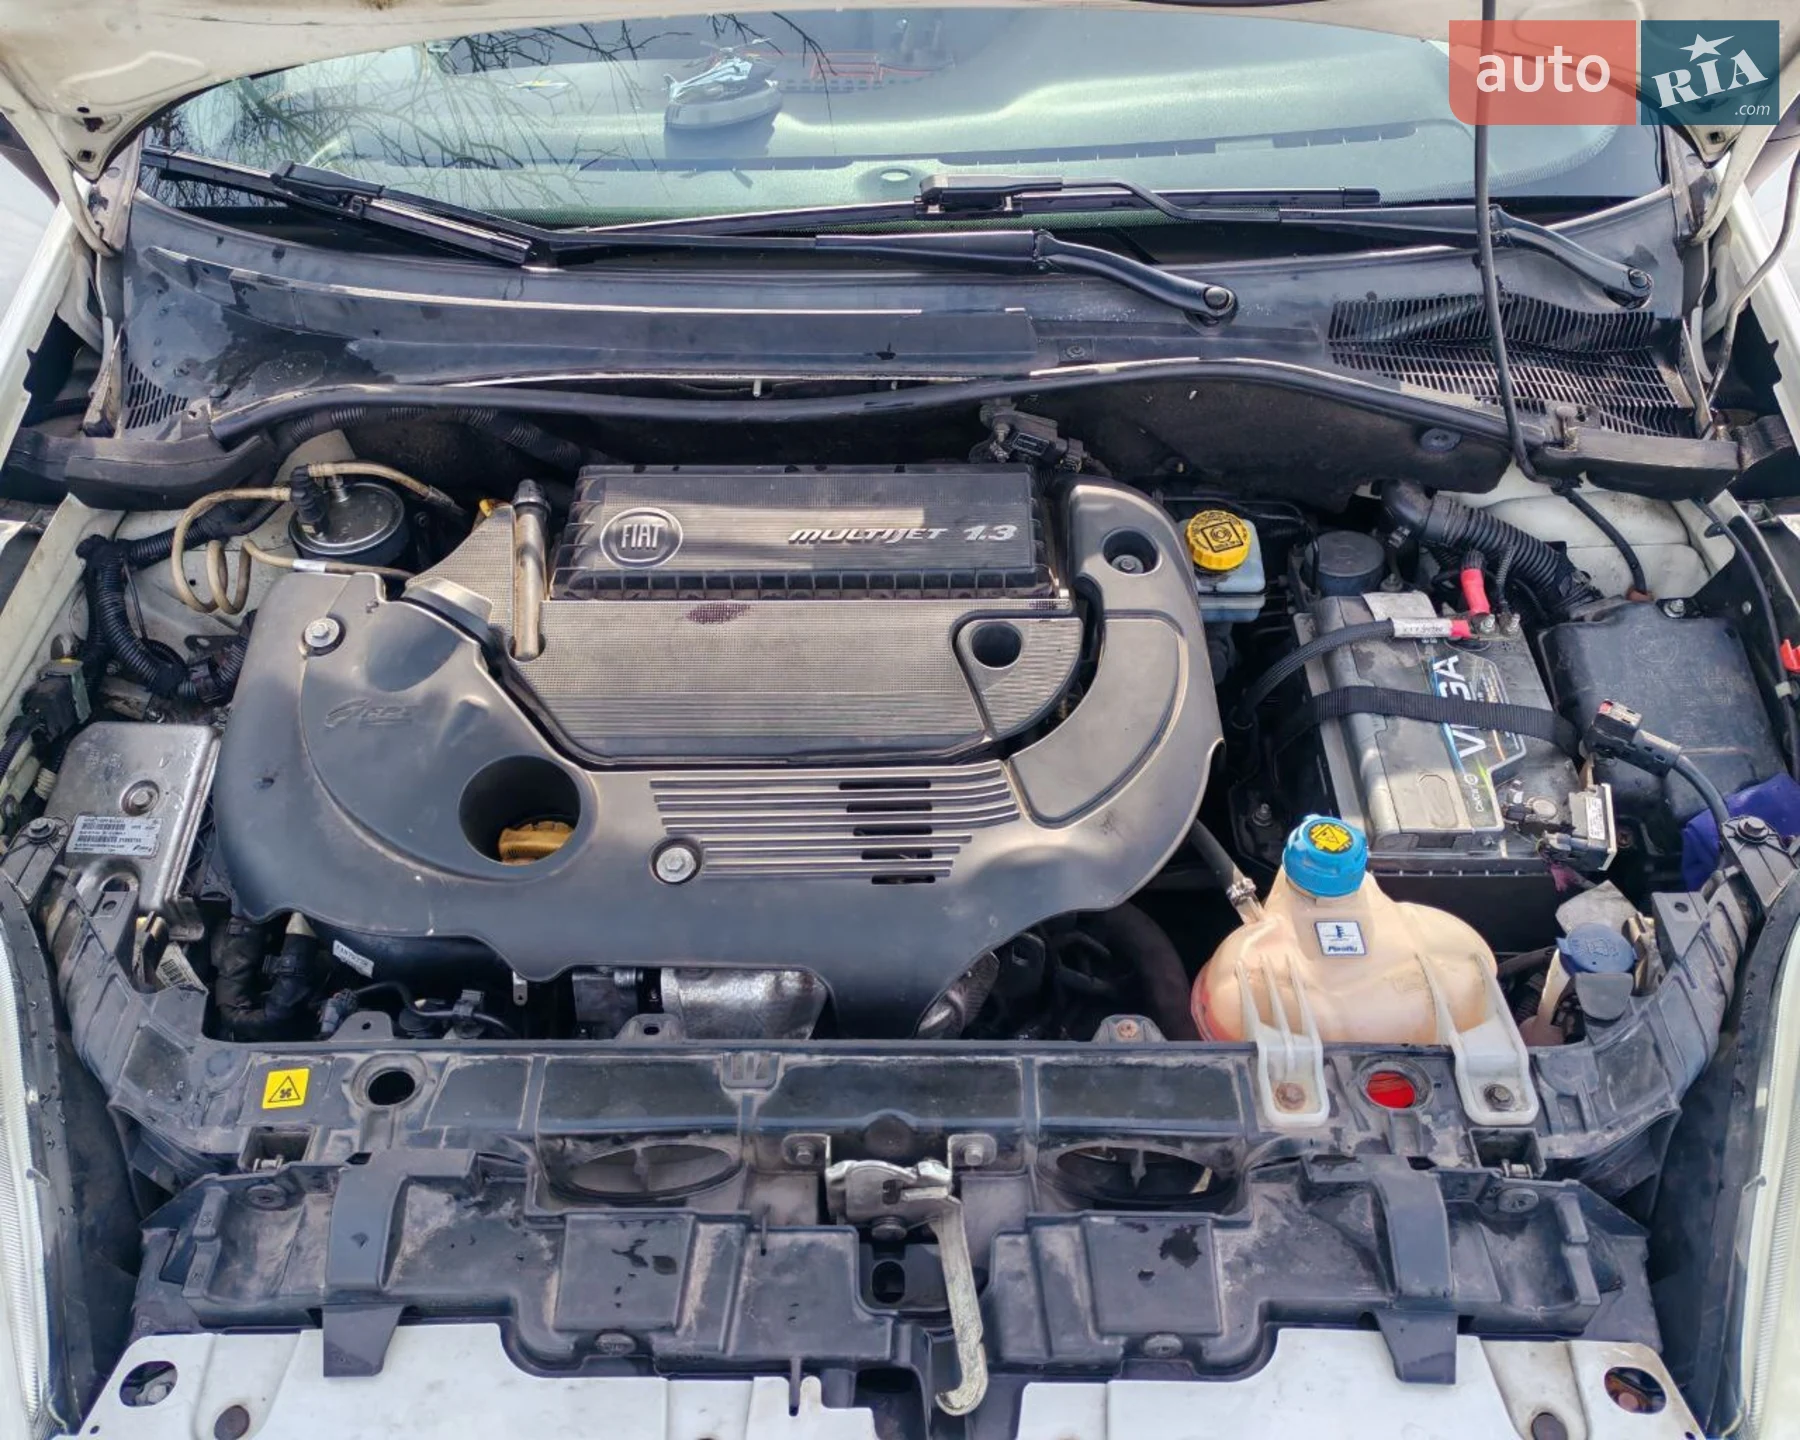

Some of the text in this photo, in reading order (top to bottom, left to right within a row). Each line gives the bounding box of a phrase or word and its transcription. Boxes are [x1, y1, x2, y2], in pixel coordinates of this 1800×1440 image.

[621, 523, 664, 549] FIAT
[788, 524, 1018, 545] MULTIJET 1.3
